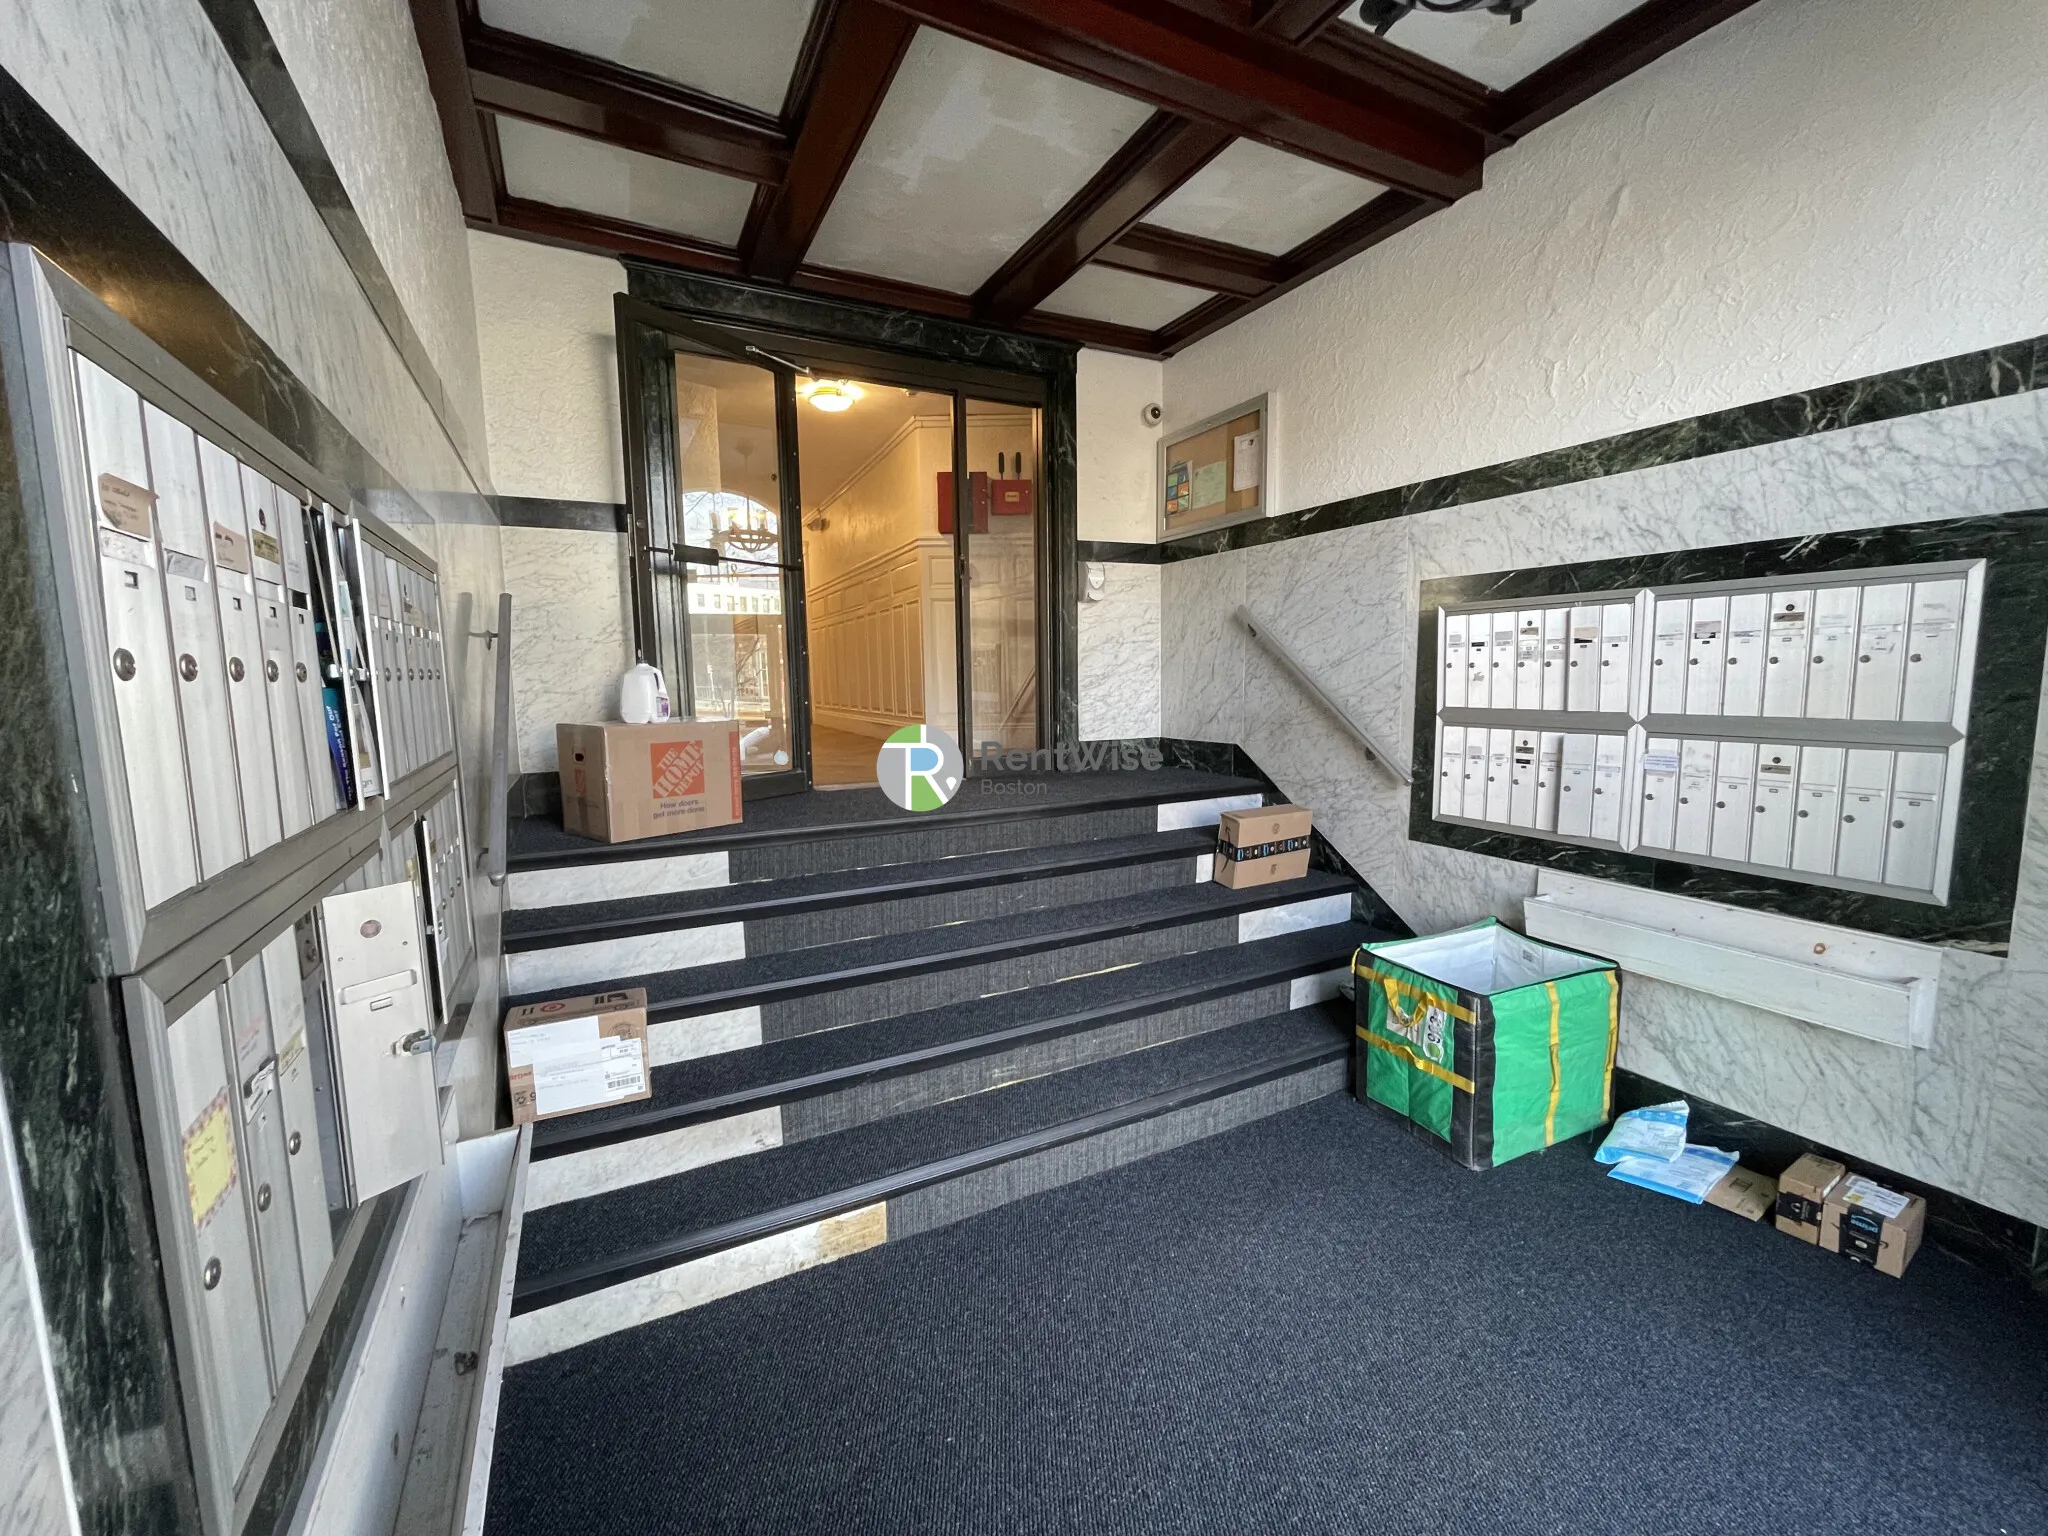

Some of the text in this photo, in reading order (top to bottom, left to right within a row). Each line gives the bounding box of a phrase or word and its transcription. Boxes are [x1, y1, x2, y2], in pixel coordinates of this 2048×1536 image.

[326, 705, 335, 721] Our
[656, 747, 679, 770] THE
[653, 740, 704, 797] HOME
[674, 759, 704, 796] DEPOT
[653, 811, 665, 820] get
[666, 809, 686, 817] more
[1851, 1219, 1878, 1233] prime
